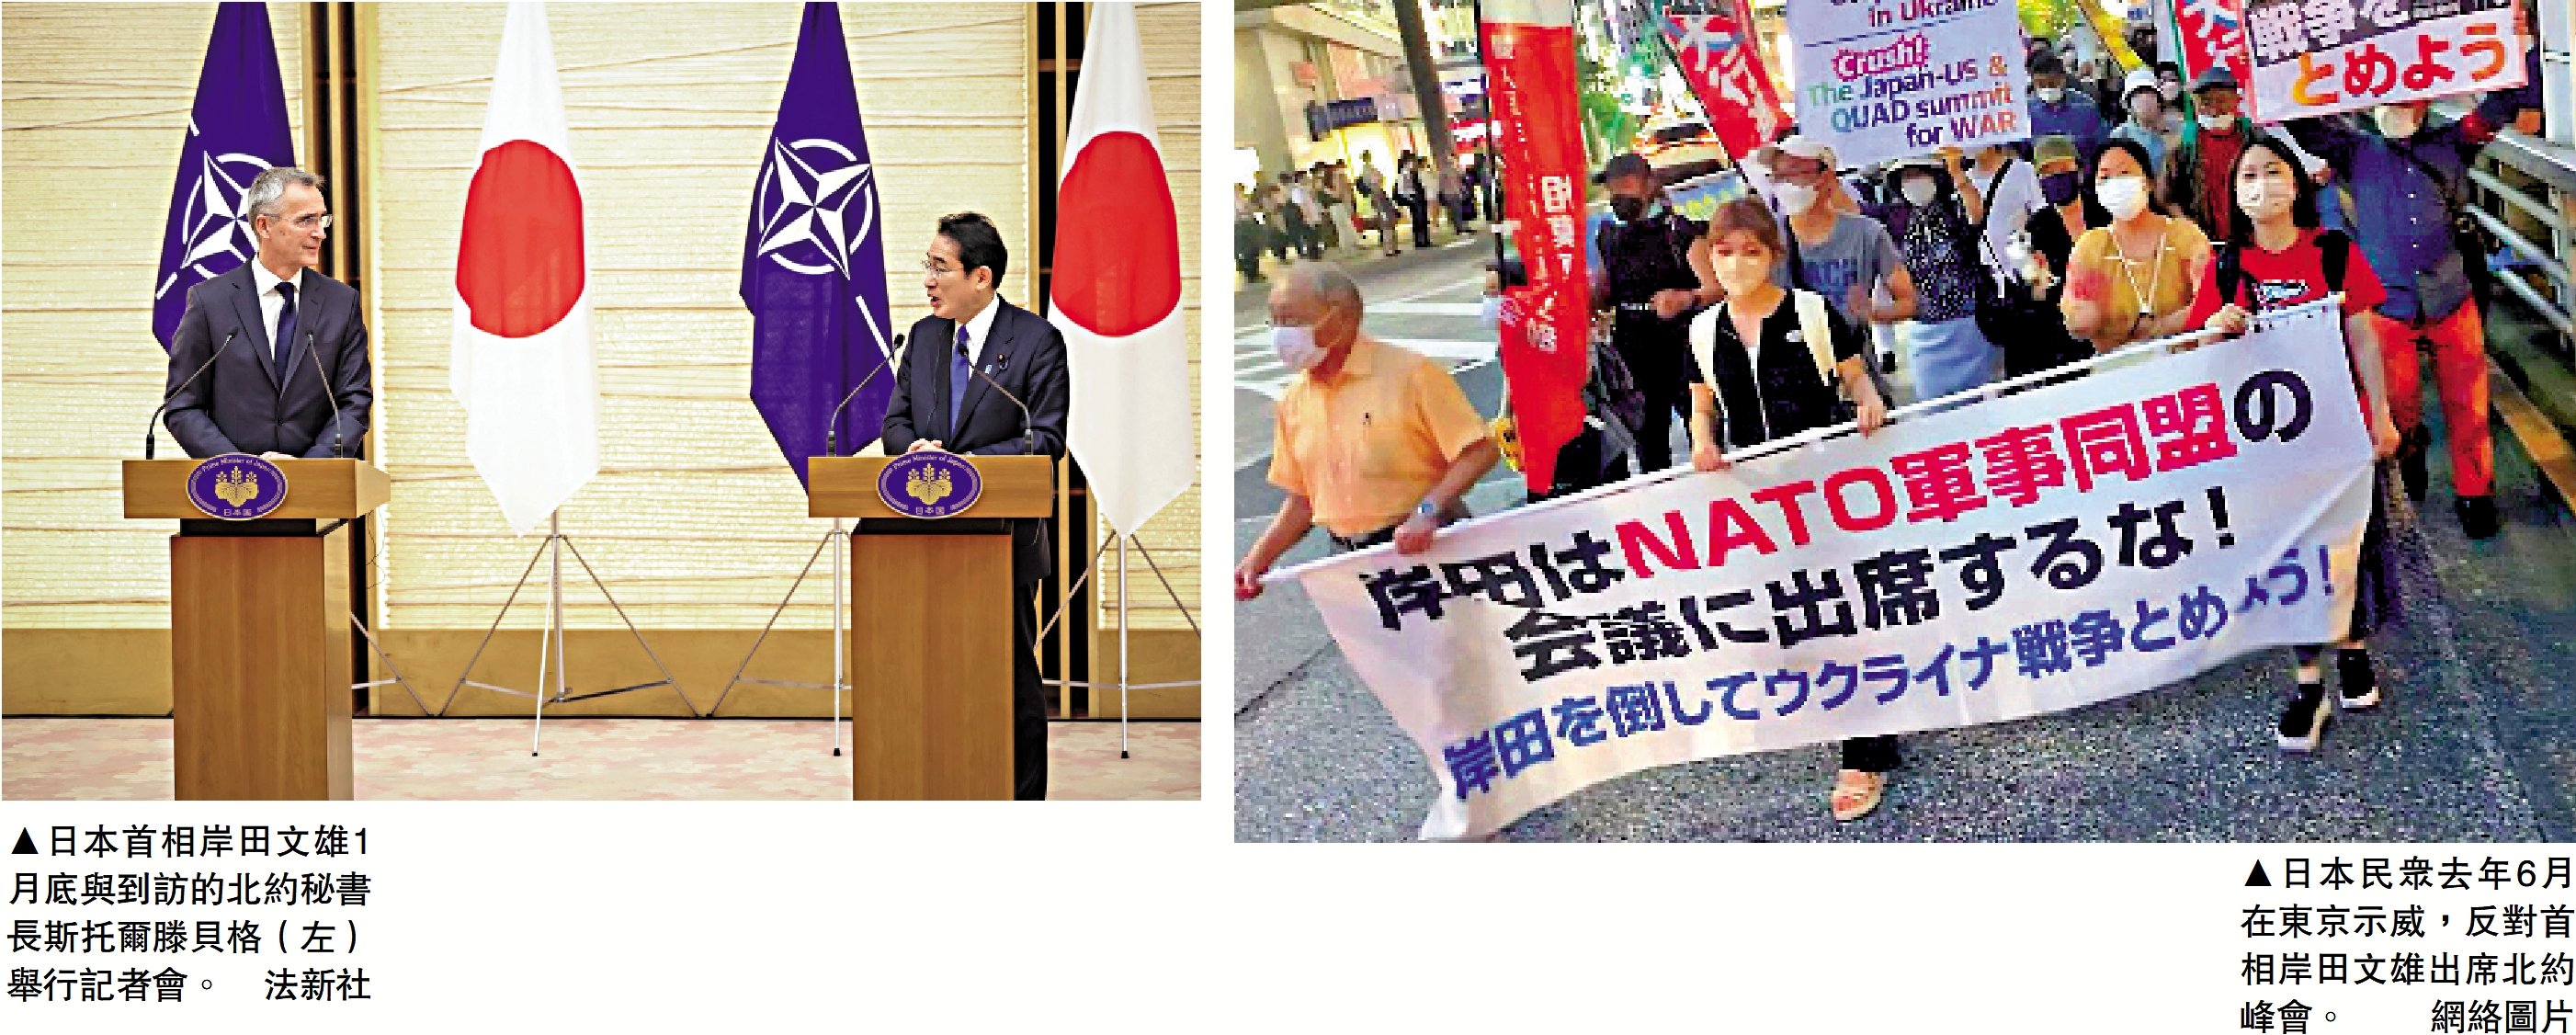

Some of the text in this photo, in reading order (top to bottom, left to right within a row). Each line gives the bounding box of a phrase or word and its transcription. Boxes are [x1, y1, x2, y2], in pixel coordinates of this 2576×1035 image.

[1868, 5, 1893, 28] in
[1807, 53, 2008, 106] The Japan-US &
[1834, 35, 1928, 81] Crush!
[2293, 22, 2506, 106] とめよう
[1831, 80, 2013, 133] QUAD summit
[1907, 108, 2018, 148] for WAR
[1359, 370, 2313, 631] 岸田はNATO軍事同盟の
[1504, 486, 2235, 683] 会議に出席するな！
